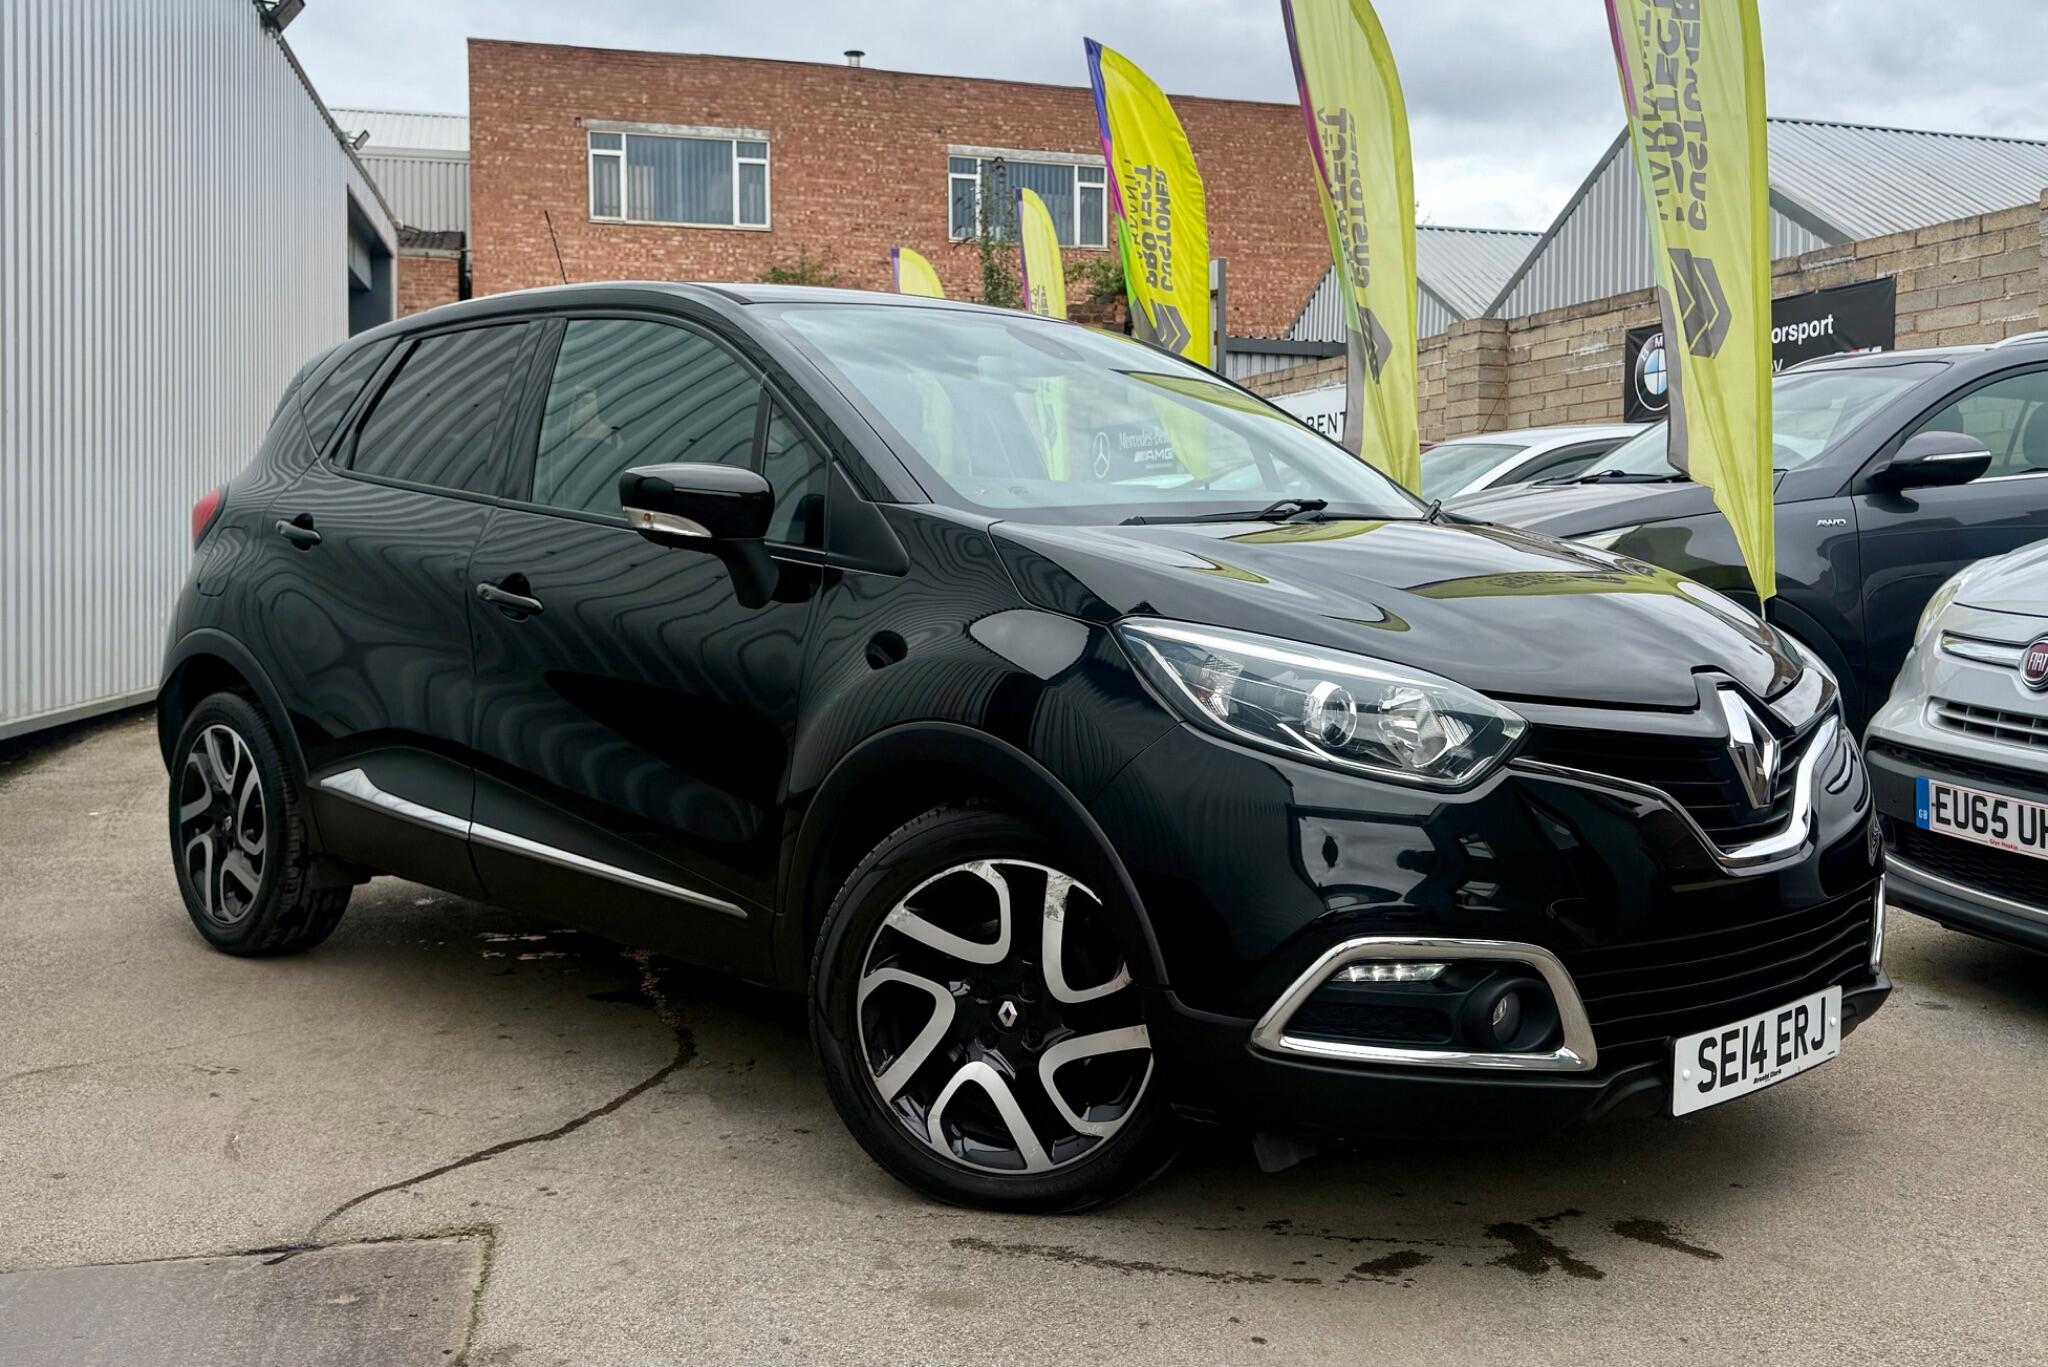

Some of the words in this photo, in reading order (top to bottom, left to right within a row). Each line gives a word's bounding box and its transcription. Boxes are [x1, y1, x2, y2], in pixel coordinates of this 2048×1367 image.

[1771, 313, 1834, 345] orsport
[1145, 447, 1174, 461] AMG
[1816, 518, 1847, 528] AWD
[1918, 808, 1928, 820] GB
[1936, 786, 2008, 839] EU65
[1697, 1020, 1768, 1094] SE14
[1776, 996, 1827, 1067] ERJ
